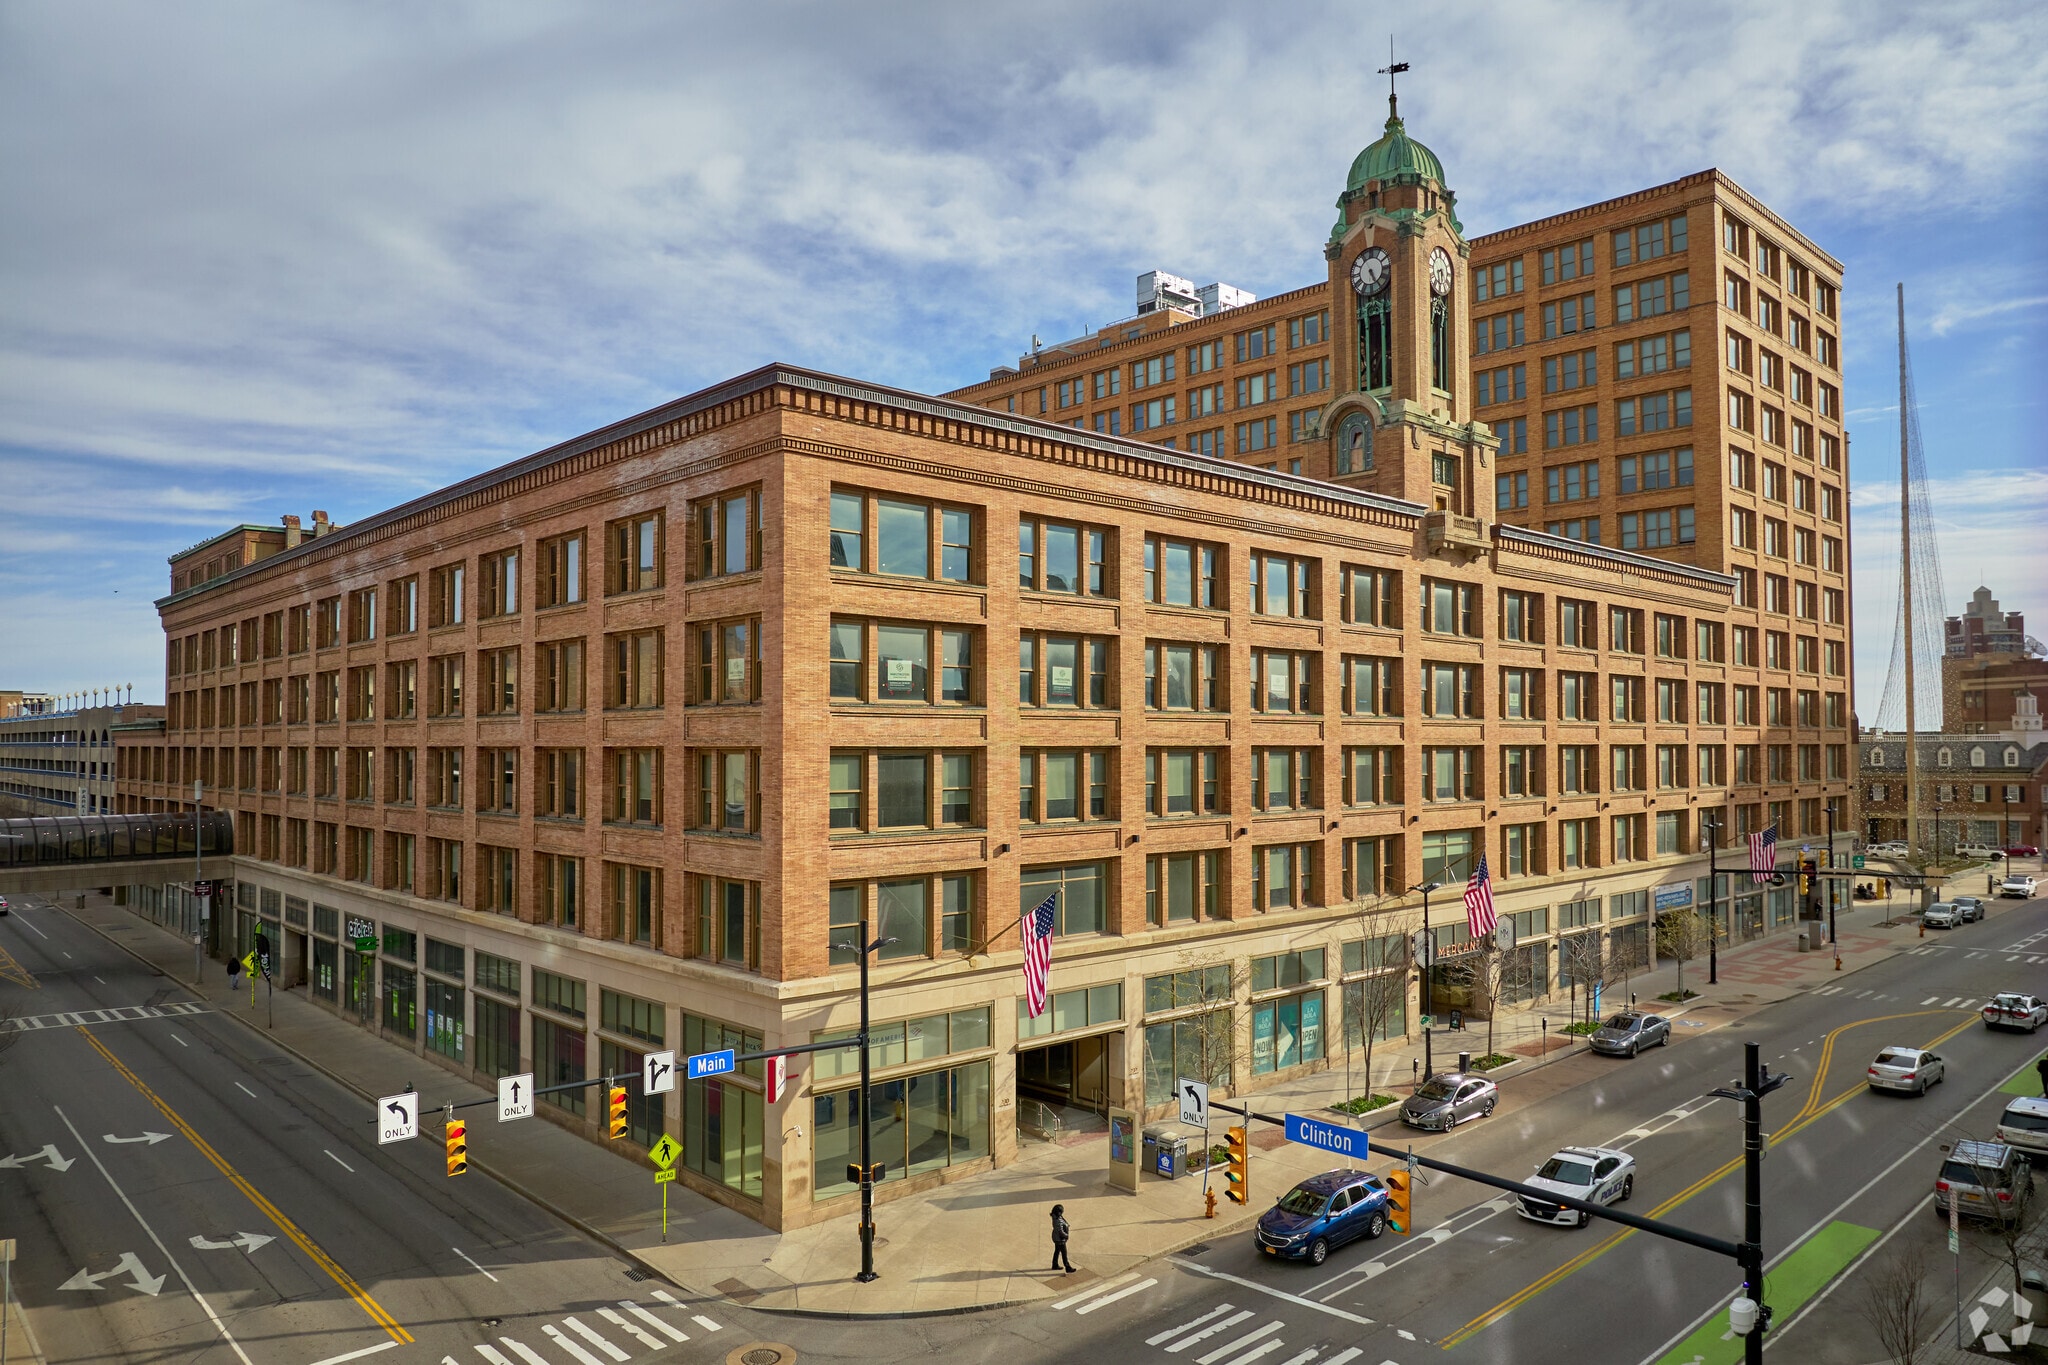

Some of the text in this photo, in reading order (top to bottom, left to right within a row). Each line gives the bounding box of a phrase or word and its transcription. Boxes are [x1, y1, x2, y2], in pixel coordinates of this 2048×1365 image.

[880, 1032, 905, 1043] AMERIC
[1256, 1039, 1273, 1054] NOW
[697, 1056, 726, 1074] Main
[504, 1104, 528, 1117] ONLY
[1183, 1111, 1205, 1125] ONLY
[385, 1126, 412, 1139] ONLY
[1300, 1122, 1352, 1152] Clinton
[657, 1171, 674, 1180] AHEAD
